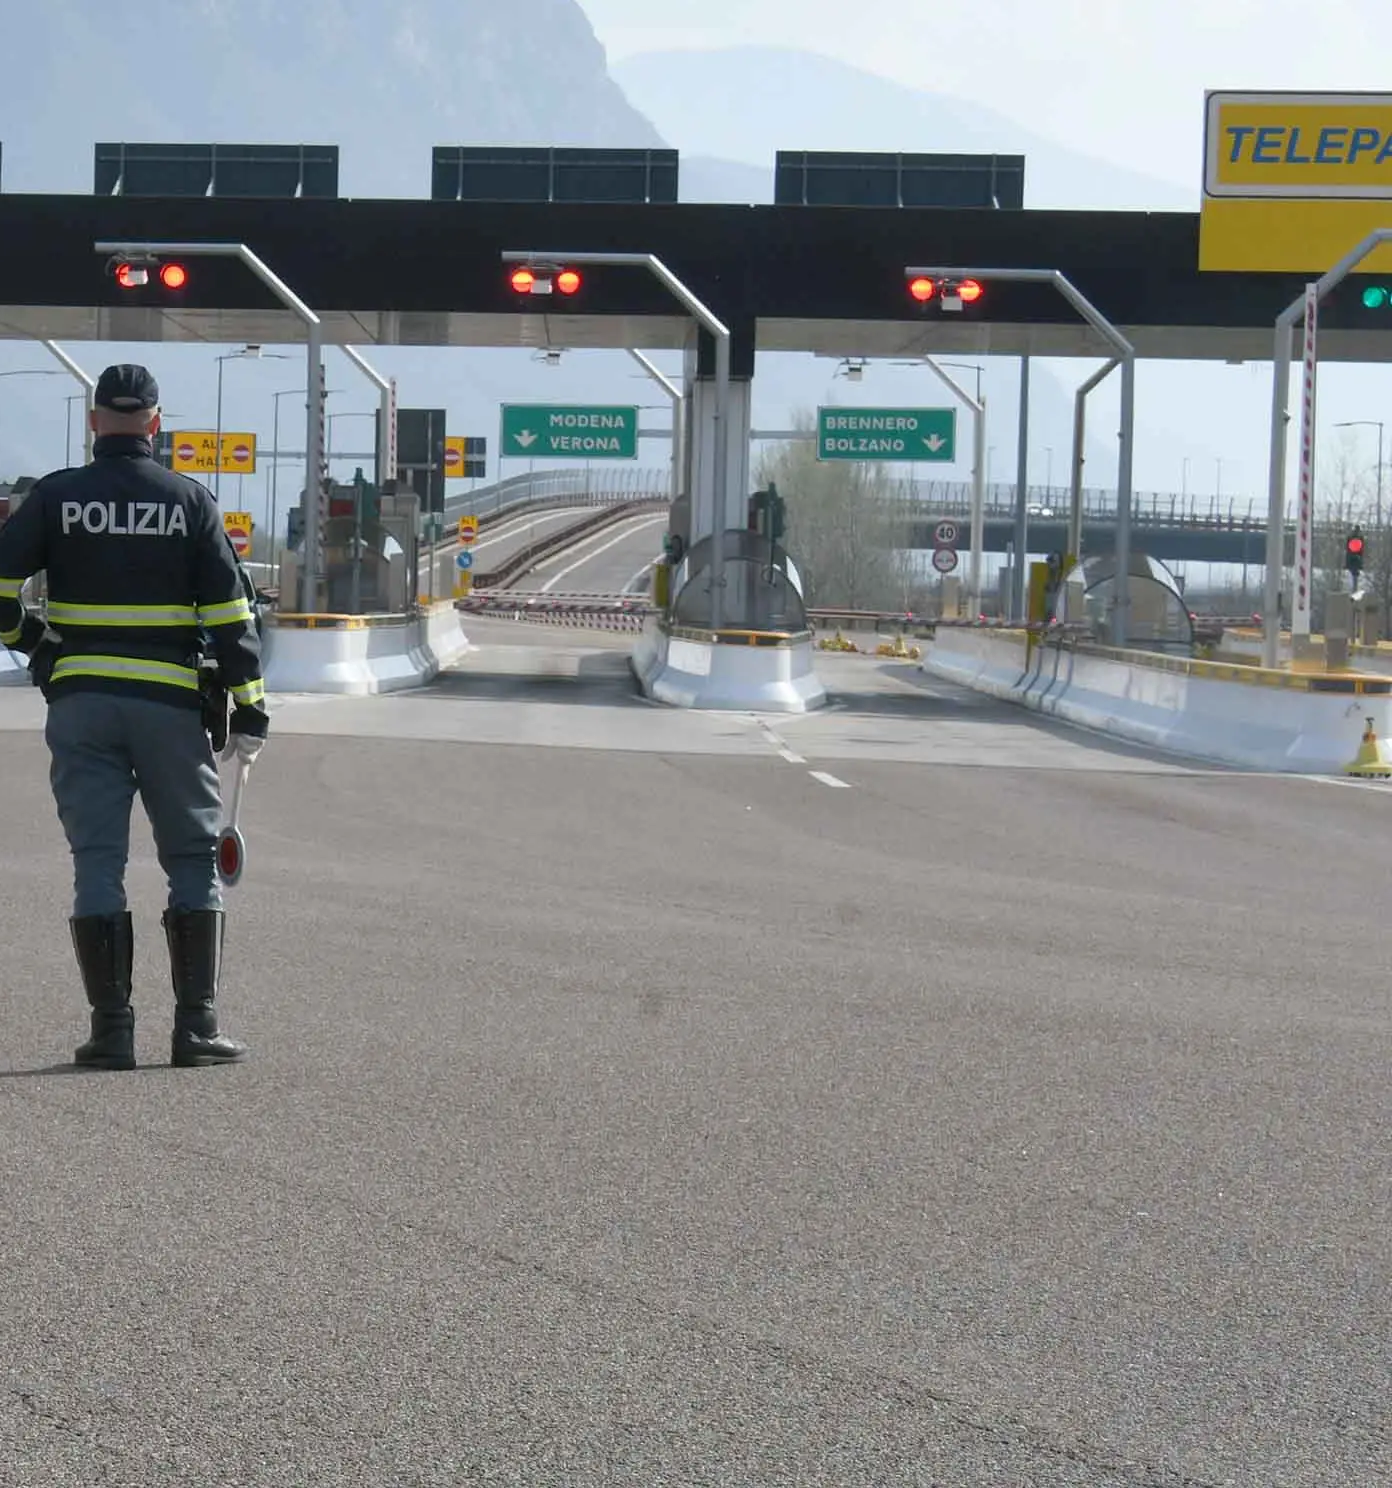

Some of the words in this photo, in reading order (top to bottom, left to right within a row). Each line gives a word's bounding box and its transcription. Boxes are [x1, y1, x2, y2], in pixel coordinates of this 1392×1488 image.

[549, 414, 625, 429] MODENA
[826, 416, 918, 430] BRENNERO
[202, 439, 226, 449] ALT
[549, 435, 621, 450] VERONA
[825, 438, 905, 451] BOLZANO
[195, 456, 231, 466] HAT
[62, 501, 188, 537] POLIZIA
[225, 515, 249, 525] ALT
[938, 526, 954, 540] 40
